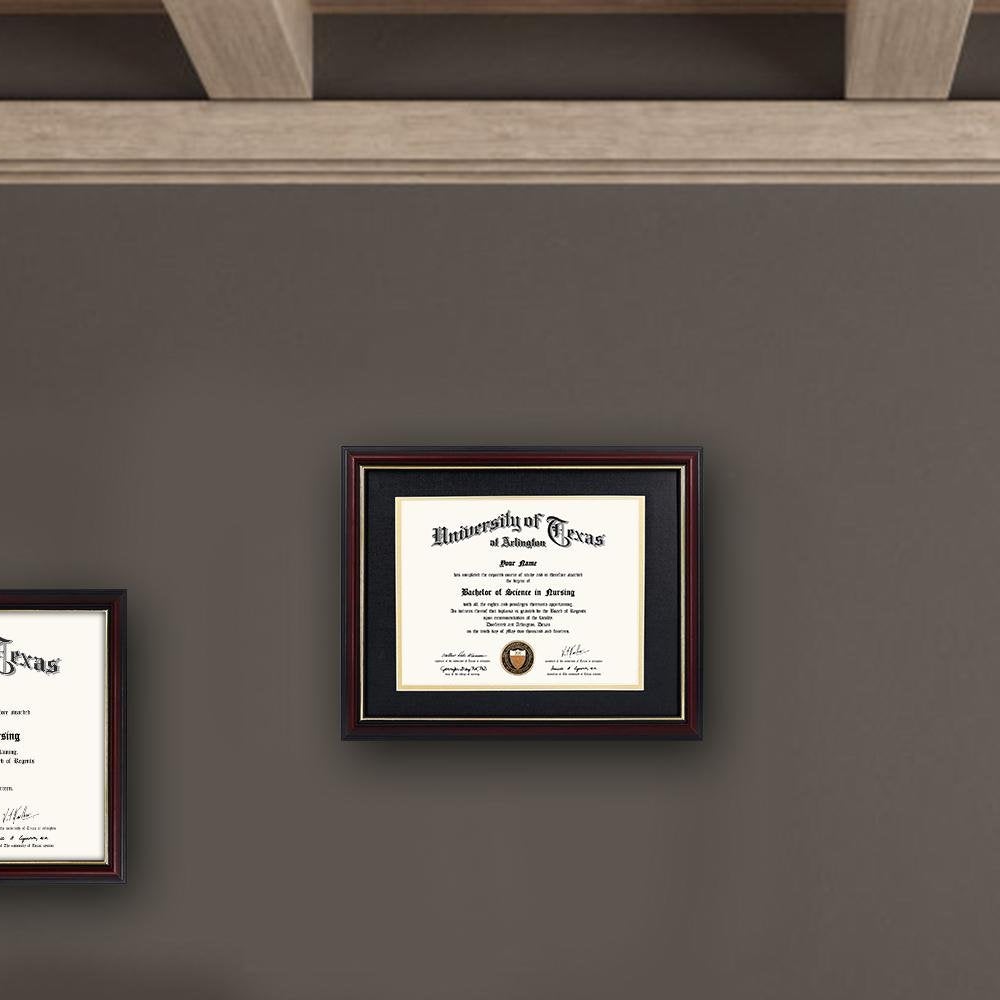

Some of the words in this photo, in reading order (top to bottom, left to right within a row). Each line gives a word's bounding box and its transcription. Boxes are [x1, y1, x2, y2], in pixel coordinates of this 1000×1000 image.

[431, 510, 522, 547] University
[524, 513, 545, 529] of
[546, 516, 606, 548] Texas
[501, 537, 546, 549] Arlington
[518, 559, 538, 568] Name
[461, 587, 492, 597] Bachelor
[494, 588, 502, 596] of
[505, 588, 532, 596] Science
[545, 588, 575, 597] Nursing
